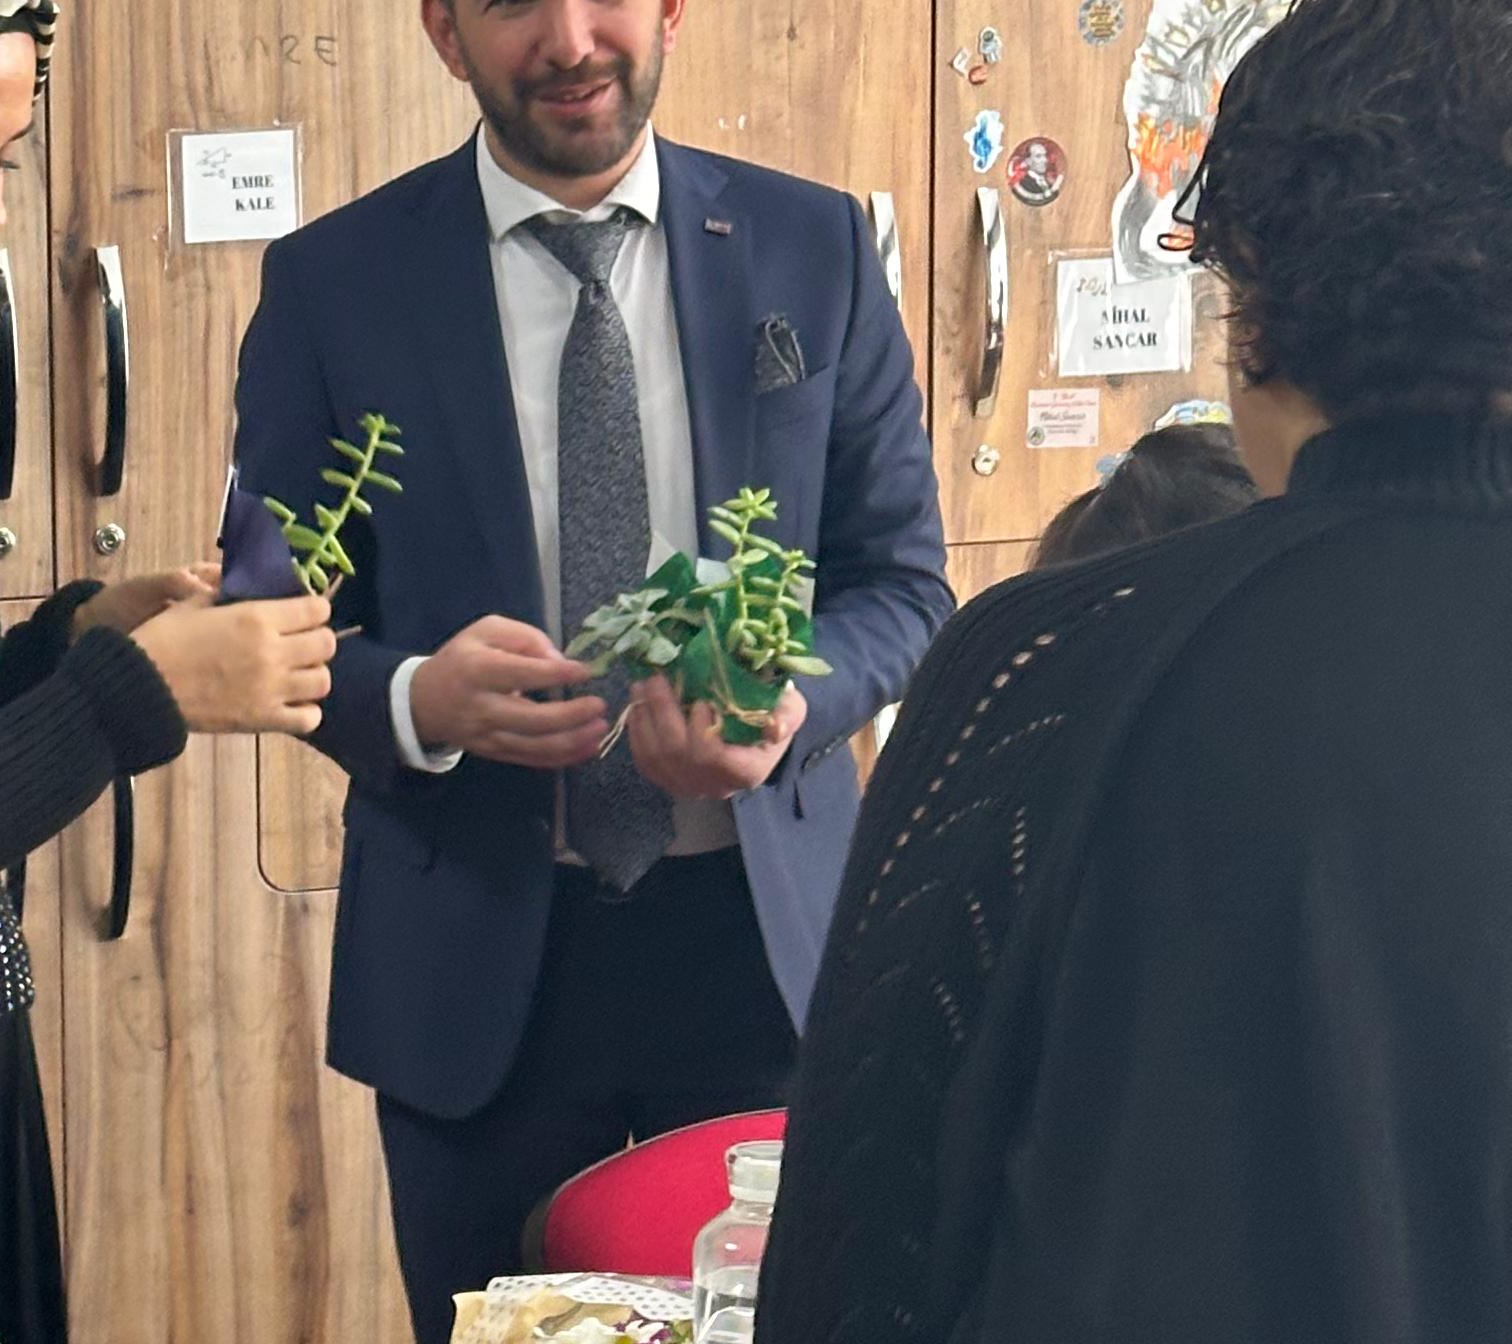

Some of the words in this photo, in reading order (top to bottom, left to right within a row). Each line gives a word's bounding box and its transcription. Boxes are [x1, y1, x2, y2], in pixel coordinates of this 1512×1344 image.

[231, 173, 275, 190] EMRE
[234, 195, 276, 212] KALE
[1093, 331, 1158, 350] SANCAR
